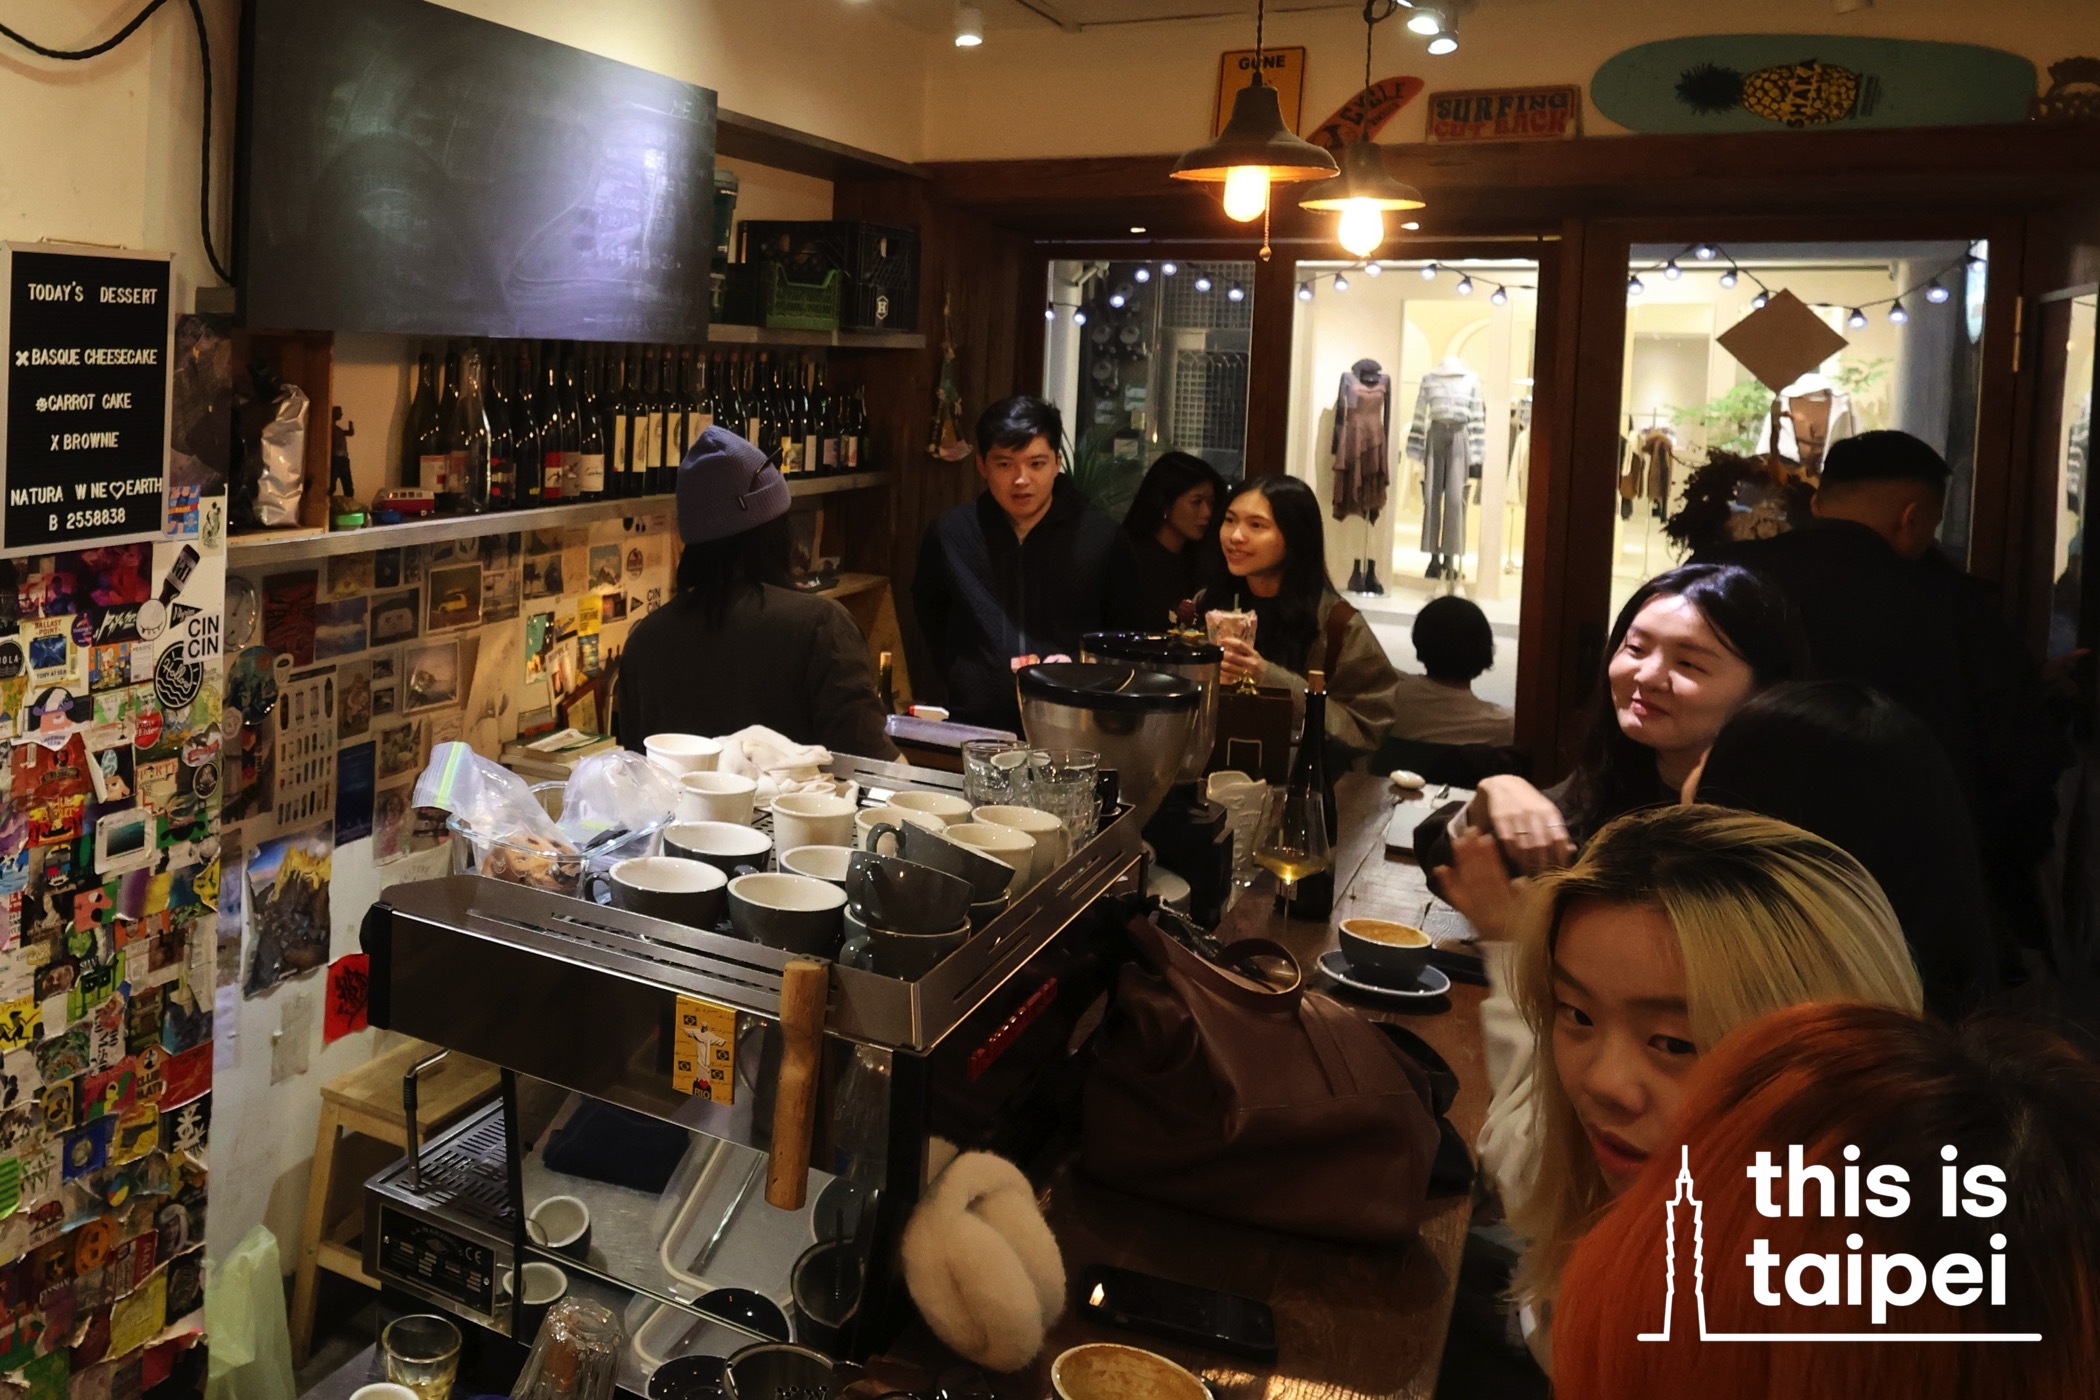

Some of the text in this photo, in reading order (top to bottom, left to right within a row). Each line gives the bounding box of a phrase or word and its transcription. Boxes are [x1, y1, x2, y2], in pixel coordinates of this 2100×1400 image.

[1436, 92, 1569, 122] SURFING
[28, 281, 157, 304] TODAY'S DESSERT
[31, 349, 157, 366] BASQUE CHEESECAKE
[48, 393, 132, 411] CARROT CAKE
[63, 431, 120, 451] BROWNIE
[10, 485, 64, 507] NATURA
[126, 477, 163, 496] EARTH
[66, 507, 126, 530] 2558838
[188, 614, 219, 638] CIN
[187, 635, 219, 659] CIN
